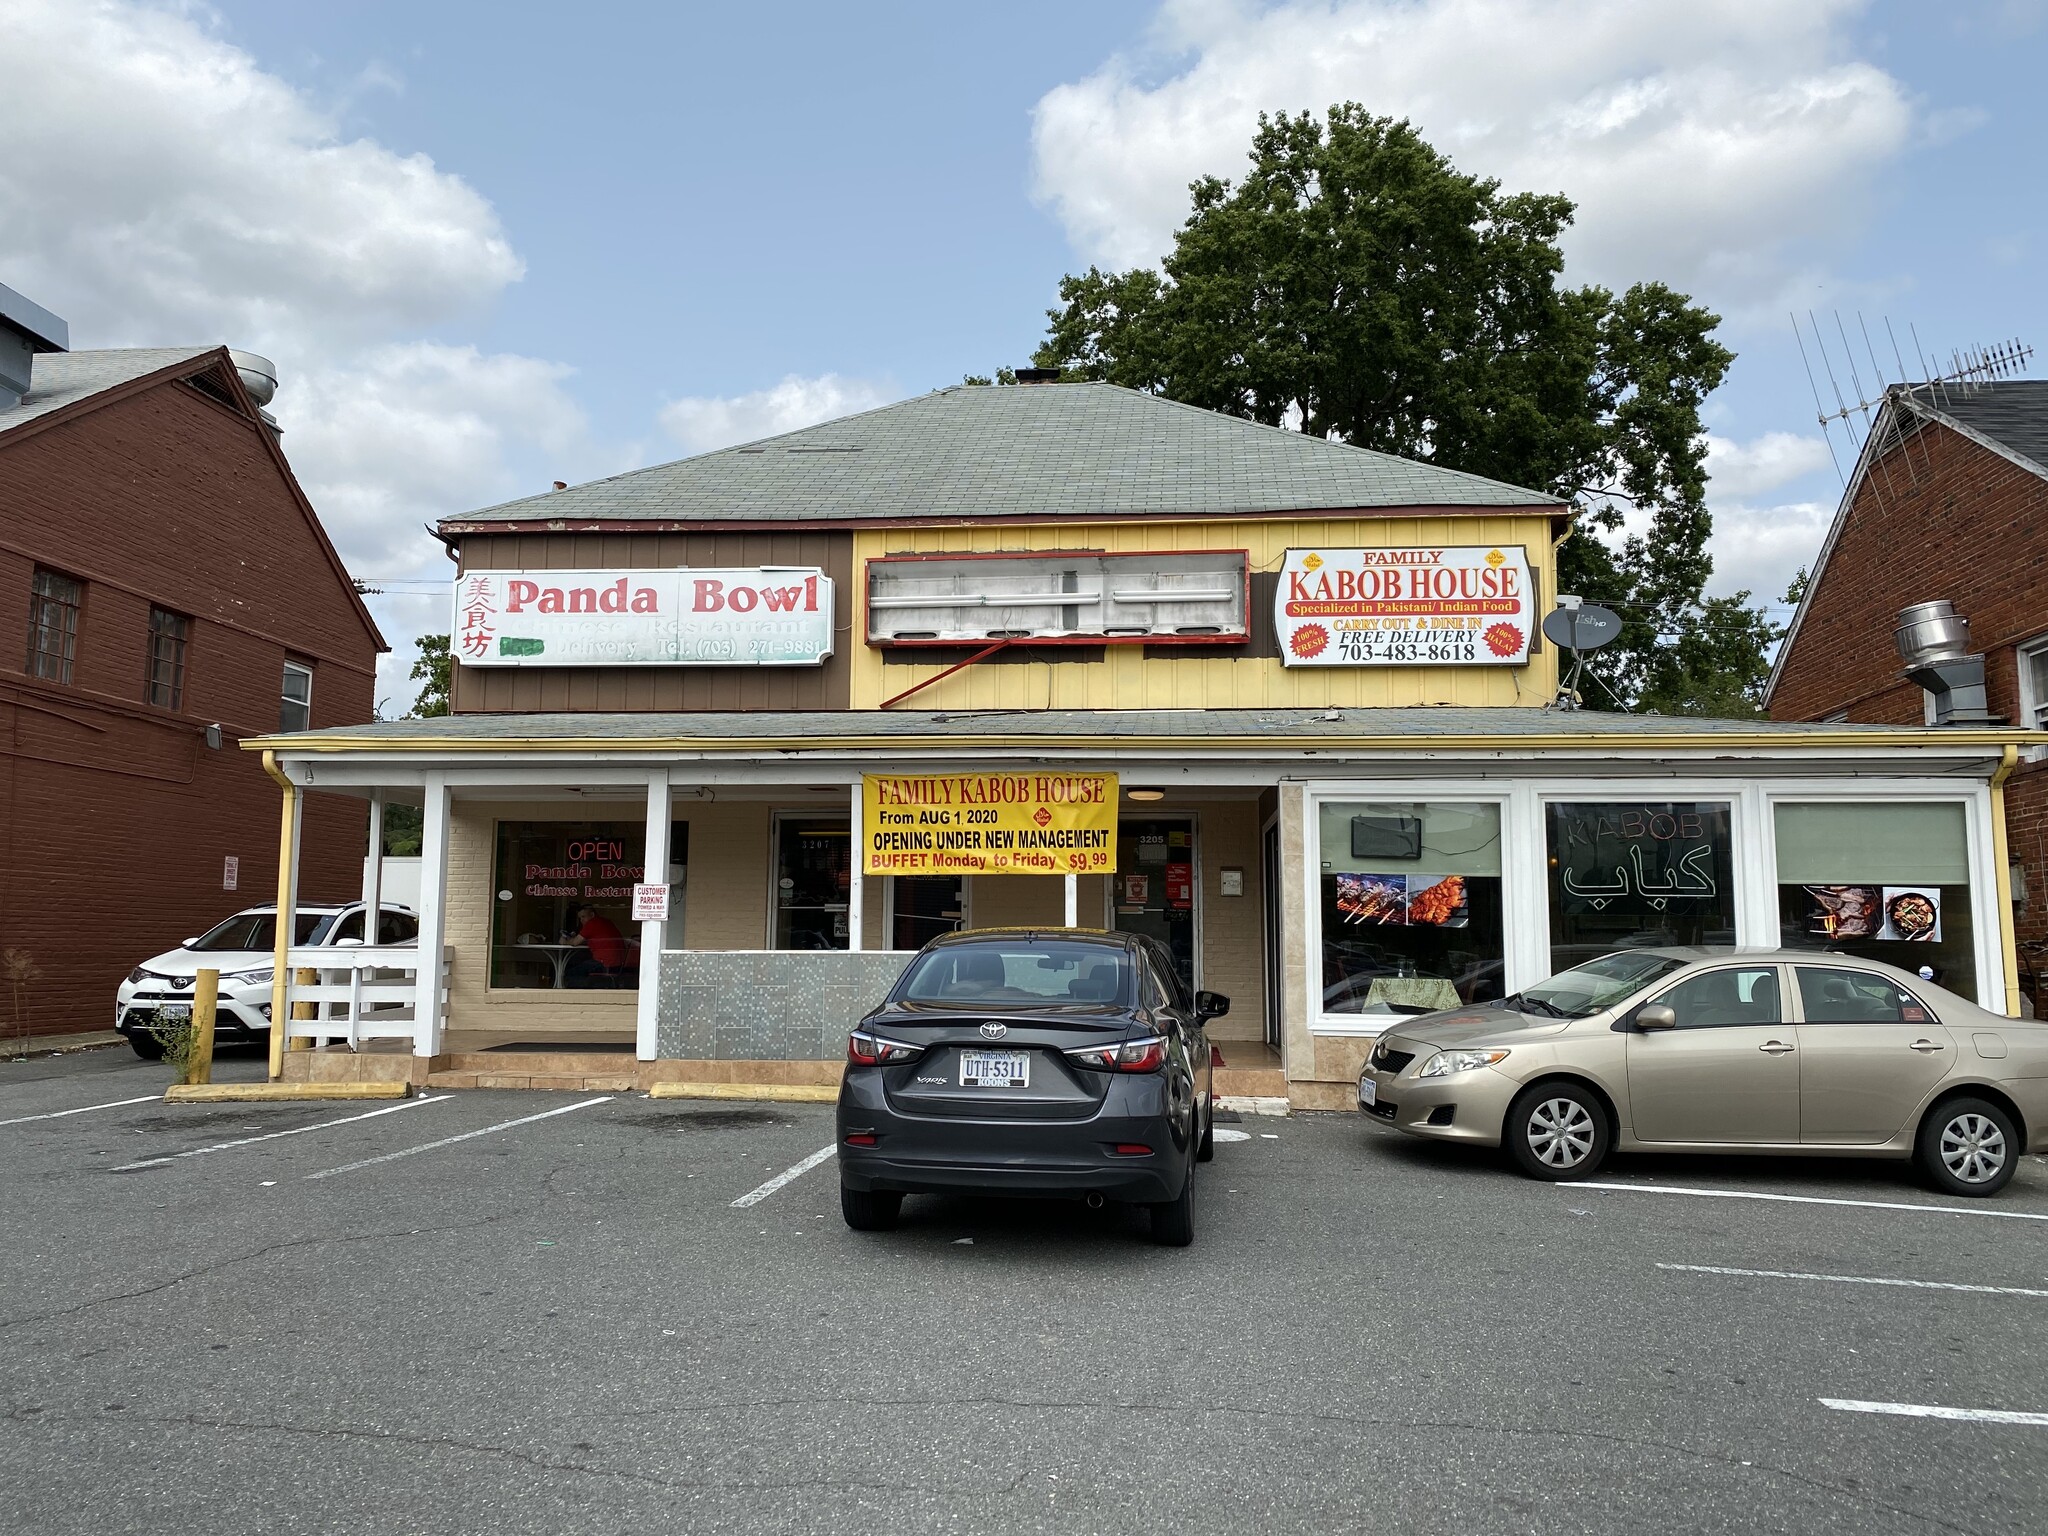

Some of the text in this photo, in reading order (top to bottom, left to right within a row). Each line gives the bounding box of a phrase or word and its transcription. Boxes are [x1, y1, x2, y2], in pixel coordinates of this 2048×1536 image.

[1363, 551, 1443, 565] FAMILY
[1288, 567, 1520, 601] KABOB HOUSE
[505, 575, 819, 614] Panda Bowl
[1292, 601, 1513, 615] Specialized in Pakistani/ Indian Food
[460, 577, 498, 658] 美食坊
[512, 617, 811, 636] Chinese Restaurant
[1333, 617, 1482, 631] CARRY OUT & DINE IN
[1295, 627, 1319, 643] 100%
[1340, 630, 1478, 643] FREE DELIVERY
[1486, 632, 1514, 654] HALAL
[1494, 627, 1515, 643] 100%
[557, 637, 638, 658] Delivery
[696, 637, 736, 658] (703)
[748, 638, 821, 655] 271-9881
[1295, 635, 1325, 656] FRESH
[1338, 643, 1475, 661] 703-483-8618
[878, 776, 1106, 805] FAMILY KABOB HOUSE
[879, 811, 914, 825] From
[919, 810, 950, 824] AUG
[967, 809, 998, 823] 2020
[1567, 811, 1704, 848] KABOB
[802, 840, 830, 849] 3207
[873, 829, 1109, 850] OPENING UNDER NEW MANAGEMENT
[1139, 835, 1164, 844] 3205
[568, 842, 622, 860] OPEN
[872, 852, 1107, 870] BUFFET Monday to Friday $9.99
[525, 863, 645, 880] Panda Bow
[1563, 845, 1716, 911] كباب
[526, 884, 578, 897] Chinese
[584, 885, 634, 898] Restaur
[637, 887, 667, 895] CUSTOMER
[639, 896, 664, 904] PARKING
[966, 1060, 1024, 1078] UTH-5311
[979, 1078, 1011, 1087] KOONS
